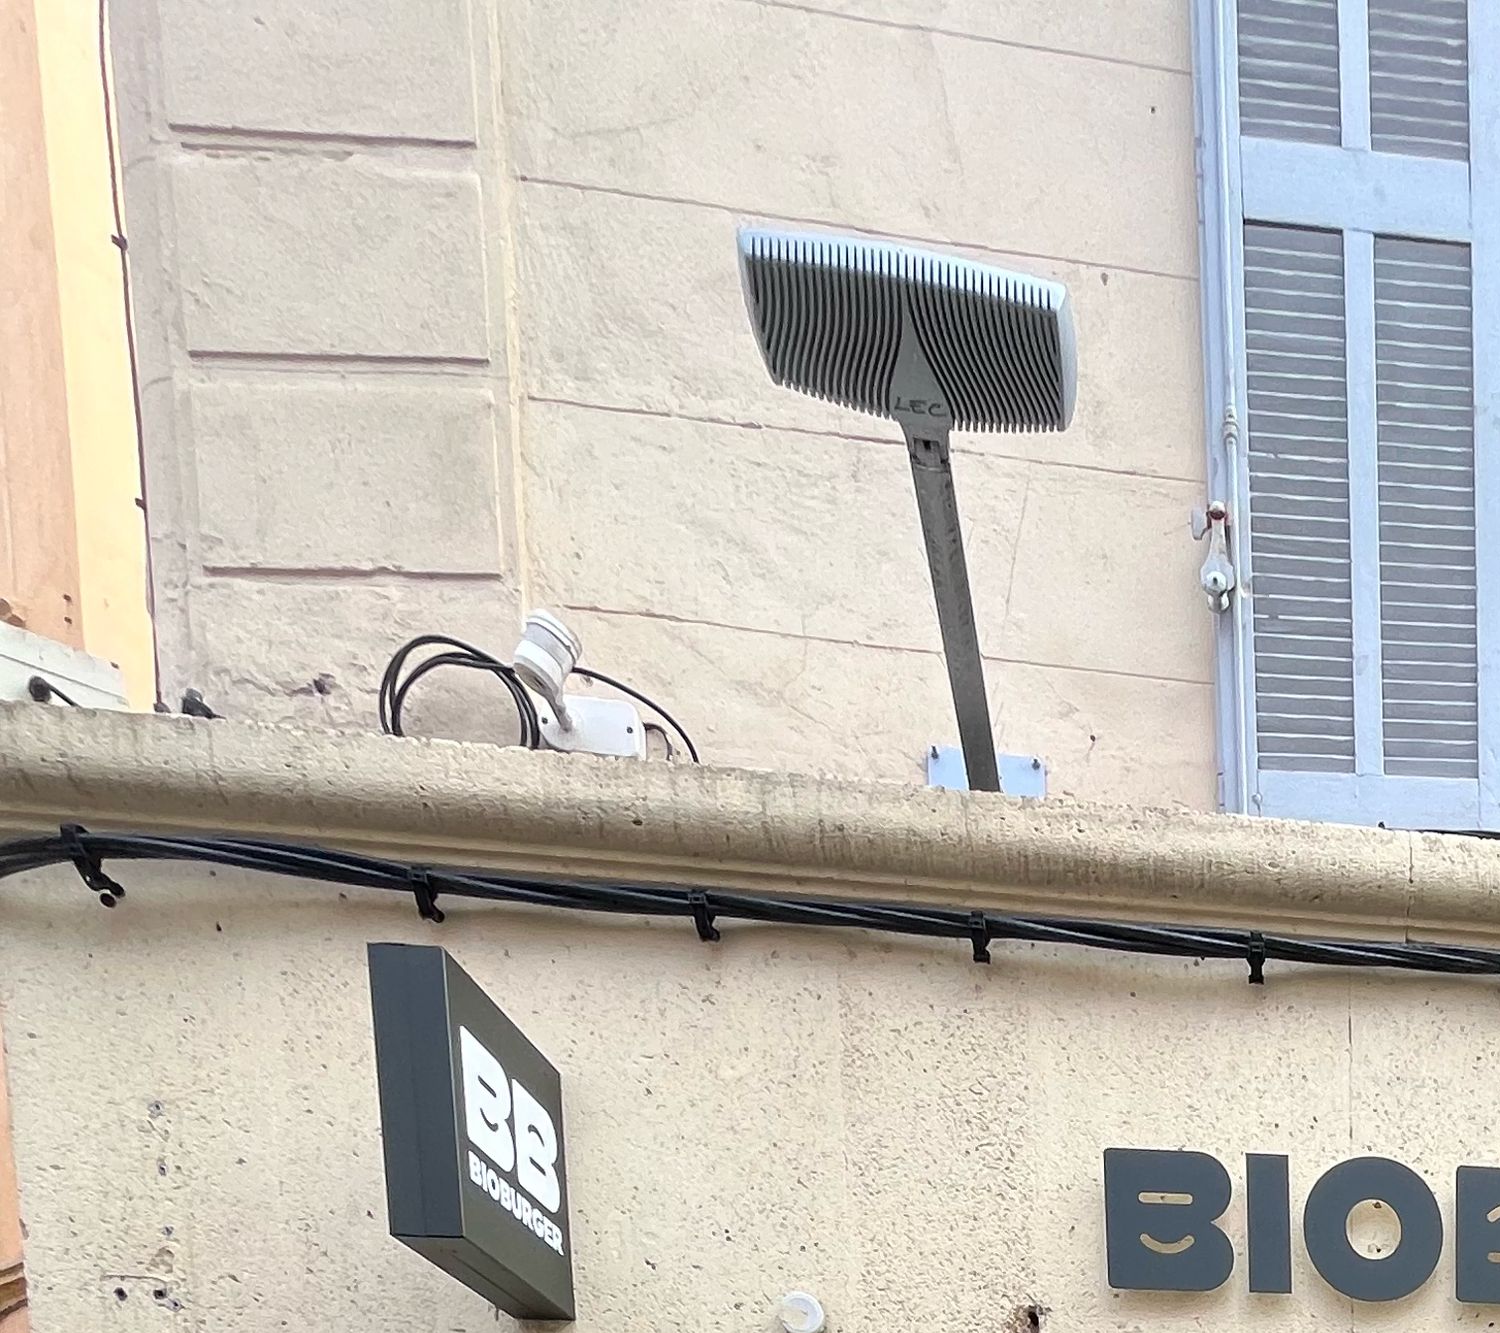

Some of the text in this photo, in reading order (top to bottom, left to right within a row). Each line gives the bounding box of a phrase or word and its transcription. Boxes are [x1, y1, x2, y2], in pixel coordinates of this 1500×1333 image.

[894, 396, 947, 417] LEC
[459, 1025, 561, 1214] BB
[466, 1150, 565, 1257] BIOBURGER
